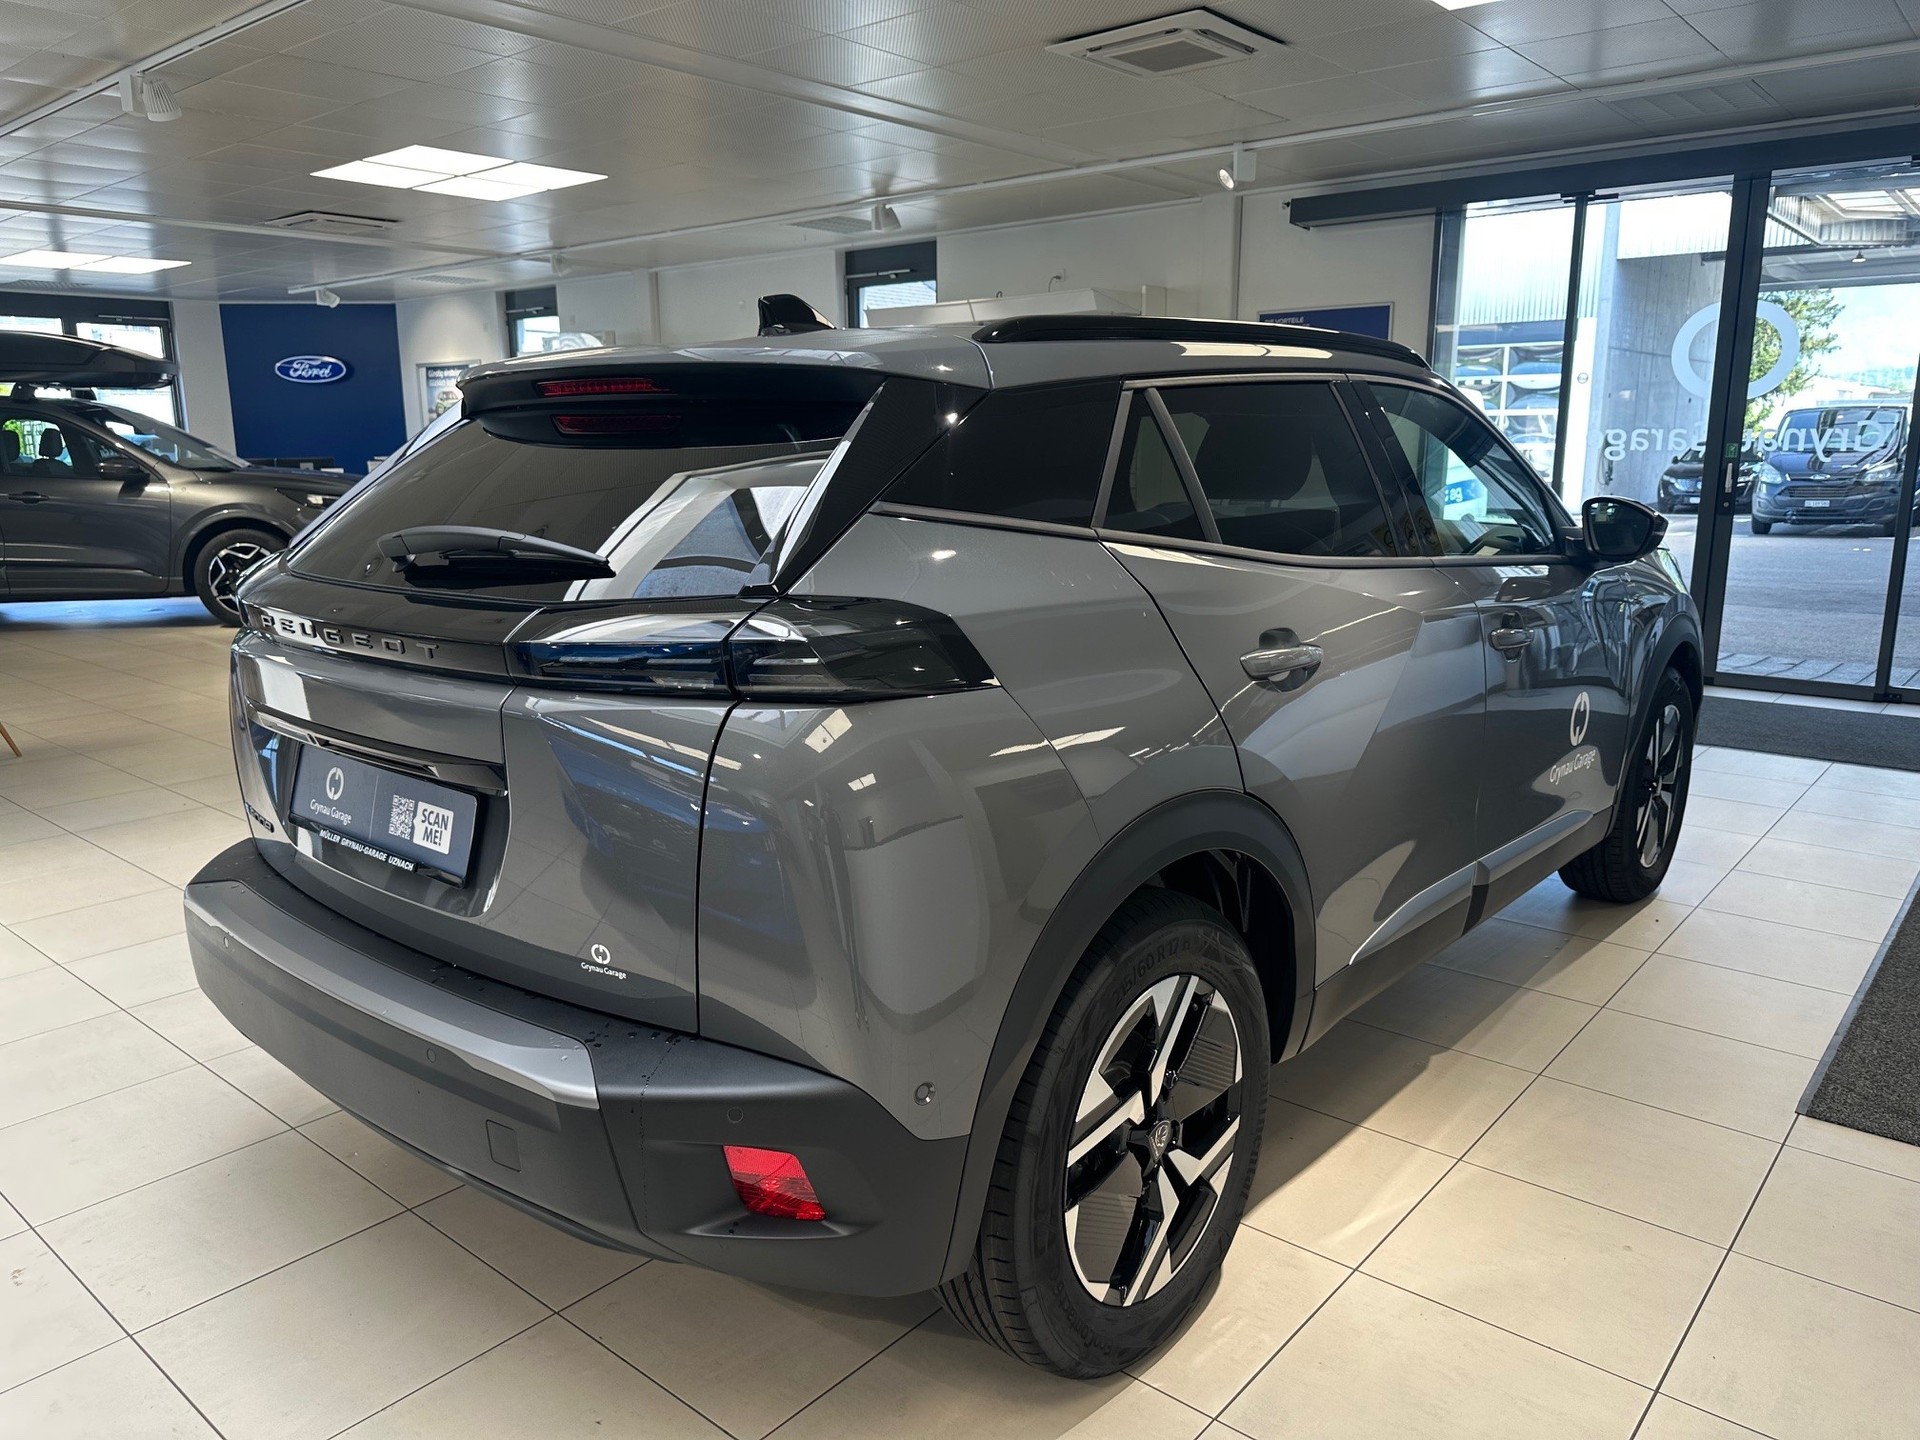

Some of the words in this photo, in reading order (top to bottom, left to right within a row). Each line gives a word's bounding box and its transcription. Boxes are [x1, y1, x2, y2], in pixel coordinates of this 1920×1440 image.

[289, 360, 332, 378] Ford
[261, 614, 440, 659] PEUGEOT
[1549, 761, 1574, 785] Grynau
[1574, 749, 1596, 769] Garage
[310, 799, 330, 816] Grynau
[331, 806, 352, 826] Garage
[421, 808, 449, 830] SCAN
[422, 829, 442, 847] ME!
[319, 829, 341, 844] MÜLLER
[340, 837, 387, 862] GRYNAU-GARAGE
[388, 855, 414, 872] UZNACH
[581, 962, 603, 973] Grynau
[604, 967, 627, 980] Garage
